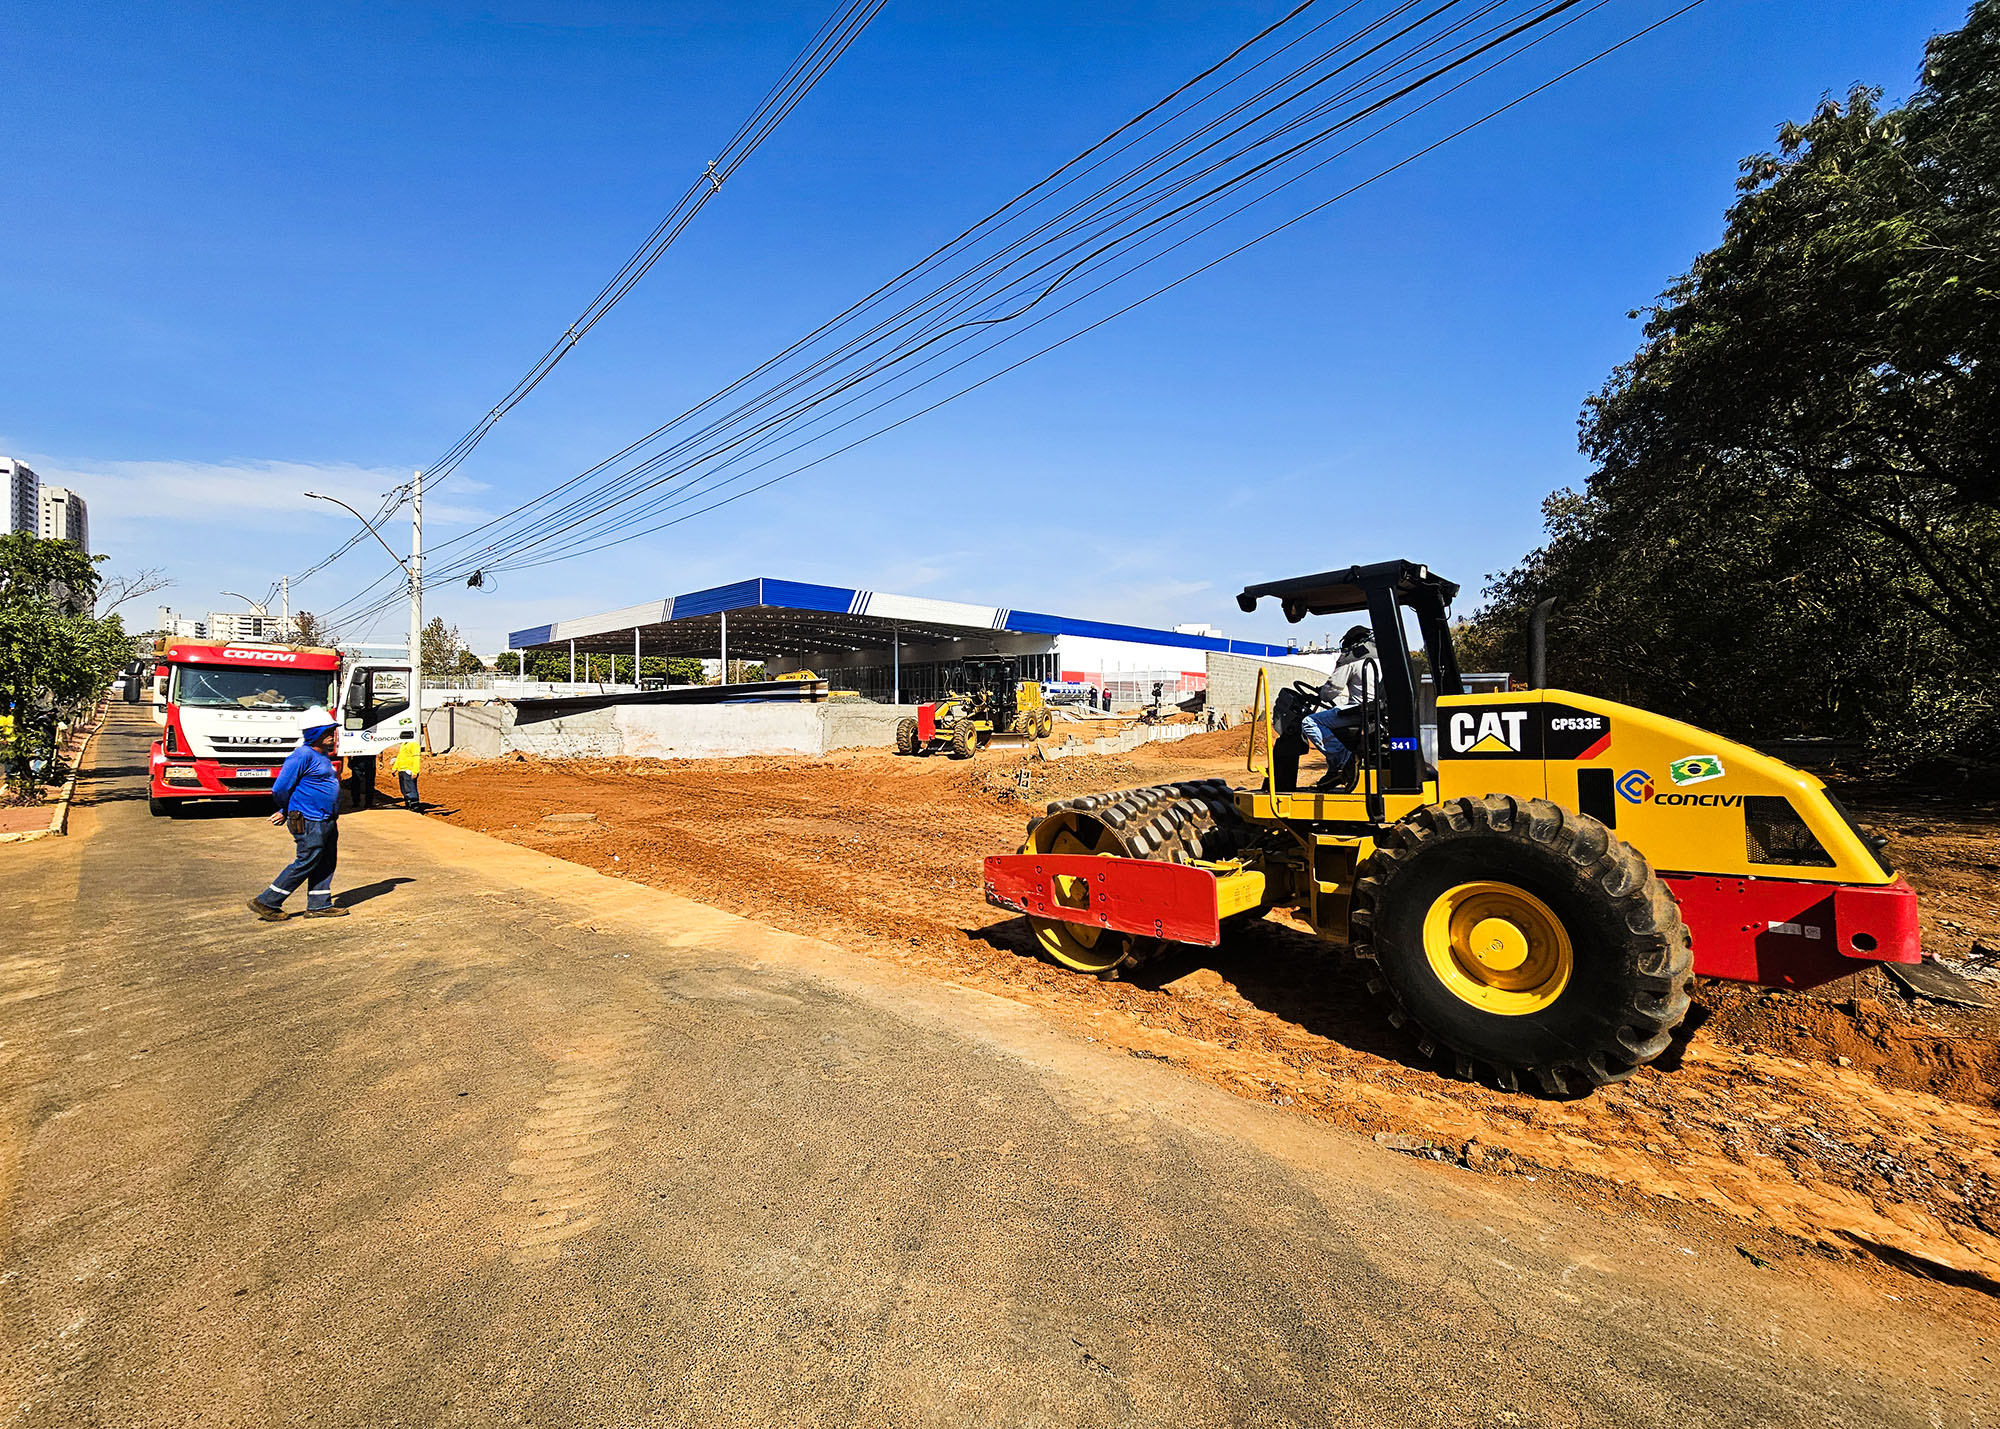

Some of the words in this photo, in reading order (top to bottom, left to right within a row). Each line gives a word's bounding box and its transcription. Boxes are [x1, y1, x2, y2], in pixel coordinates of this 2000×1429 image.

[1551, 717, 1602, 731] CP533E
[1450, 711, 1528, 753] CAT
[228, 736, 282, 745] IVECO
[1391, 741, 1411, 750] 341
[1654, 793, 1743, 808] CONCIVI
